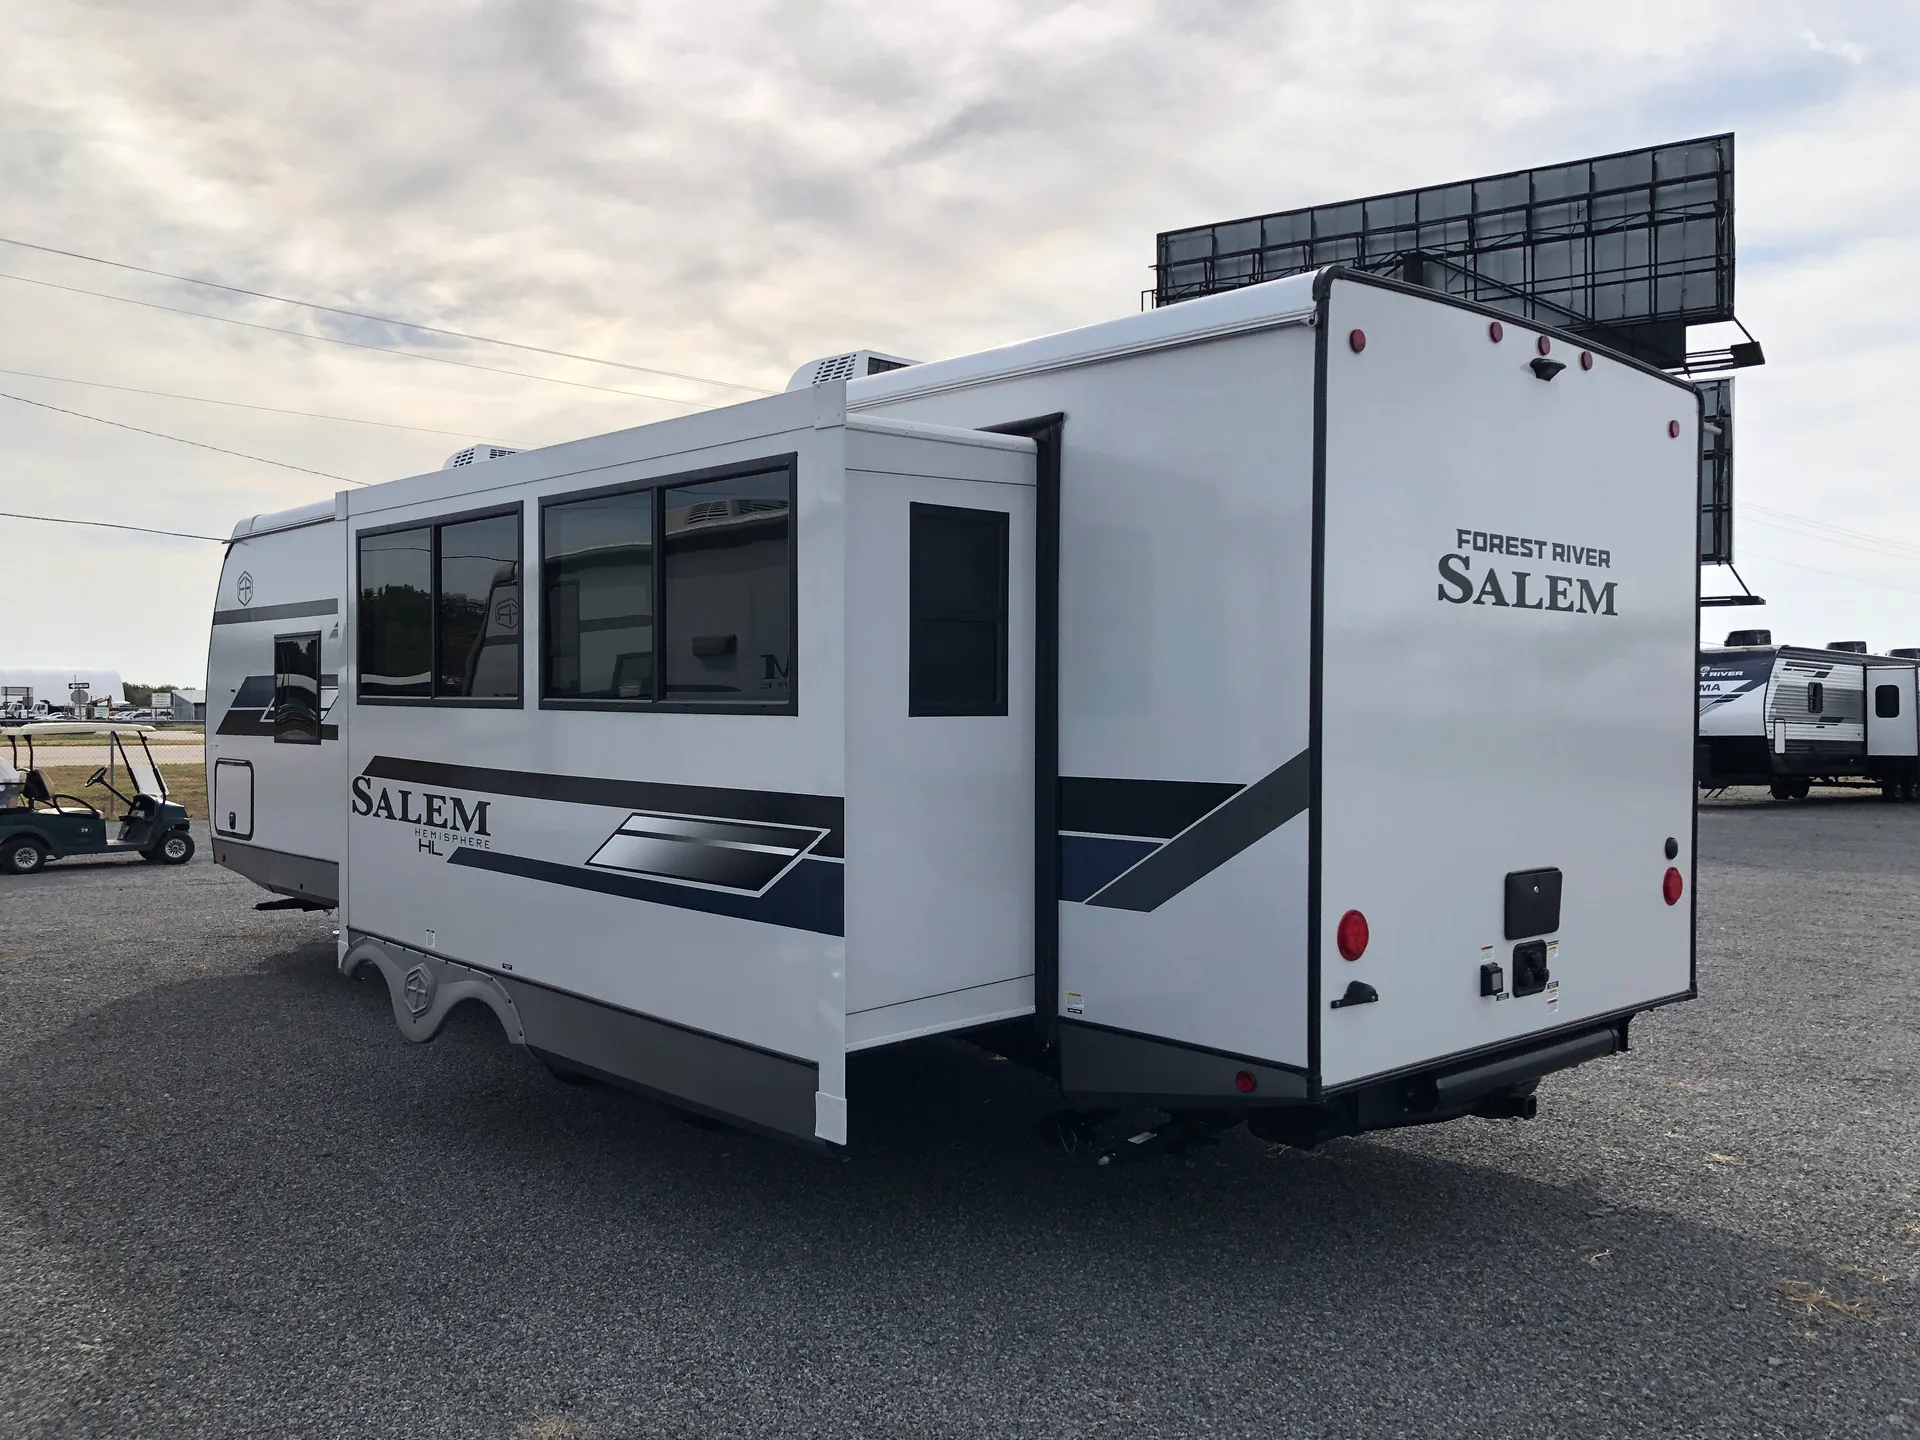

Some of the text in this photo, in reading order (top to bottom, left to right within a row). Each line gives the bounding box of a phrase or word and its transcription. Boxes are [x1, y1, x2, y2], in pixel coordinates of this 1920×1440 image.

[1456, 528, 1611, 569] FOREST RIVER
[1438, 553, 1618, 616] SALEM
[1709, 670, 1744, 678] RIVER
[352, 775, 491, 837] SALEM
[414, 827, 491, 850] HEMISPHERE
[418, 838, 444, 857] HL
